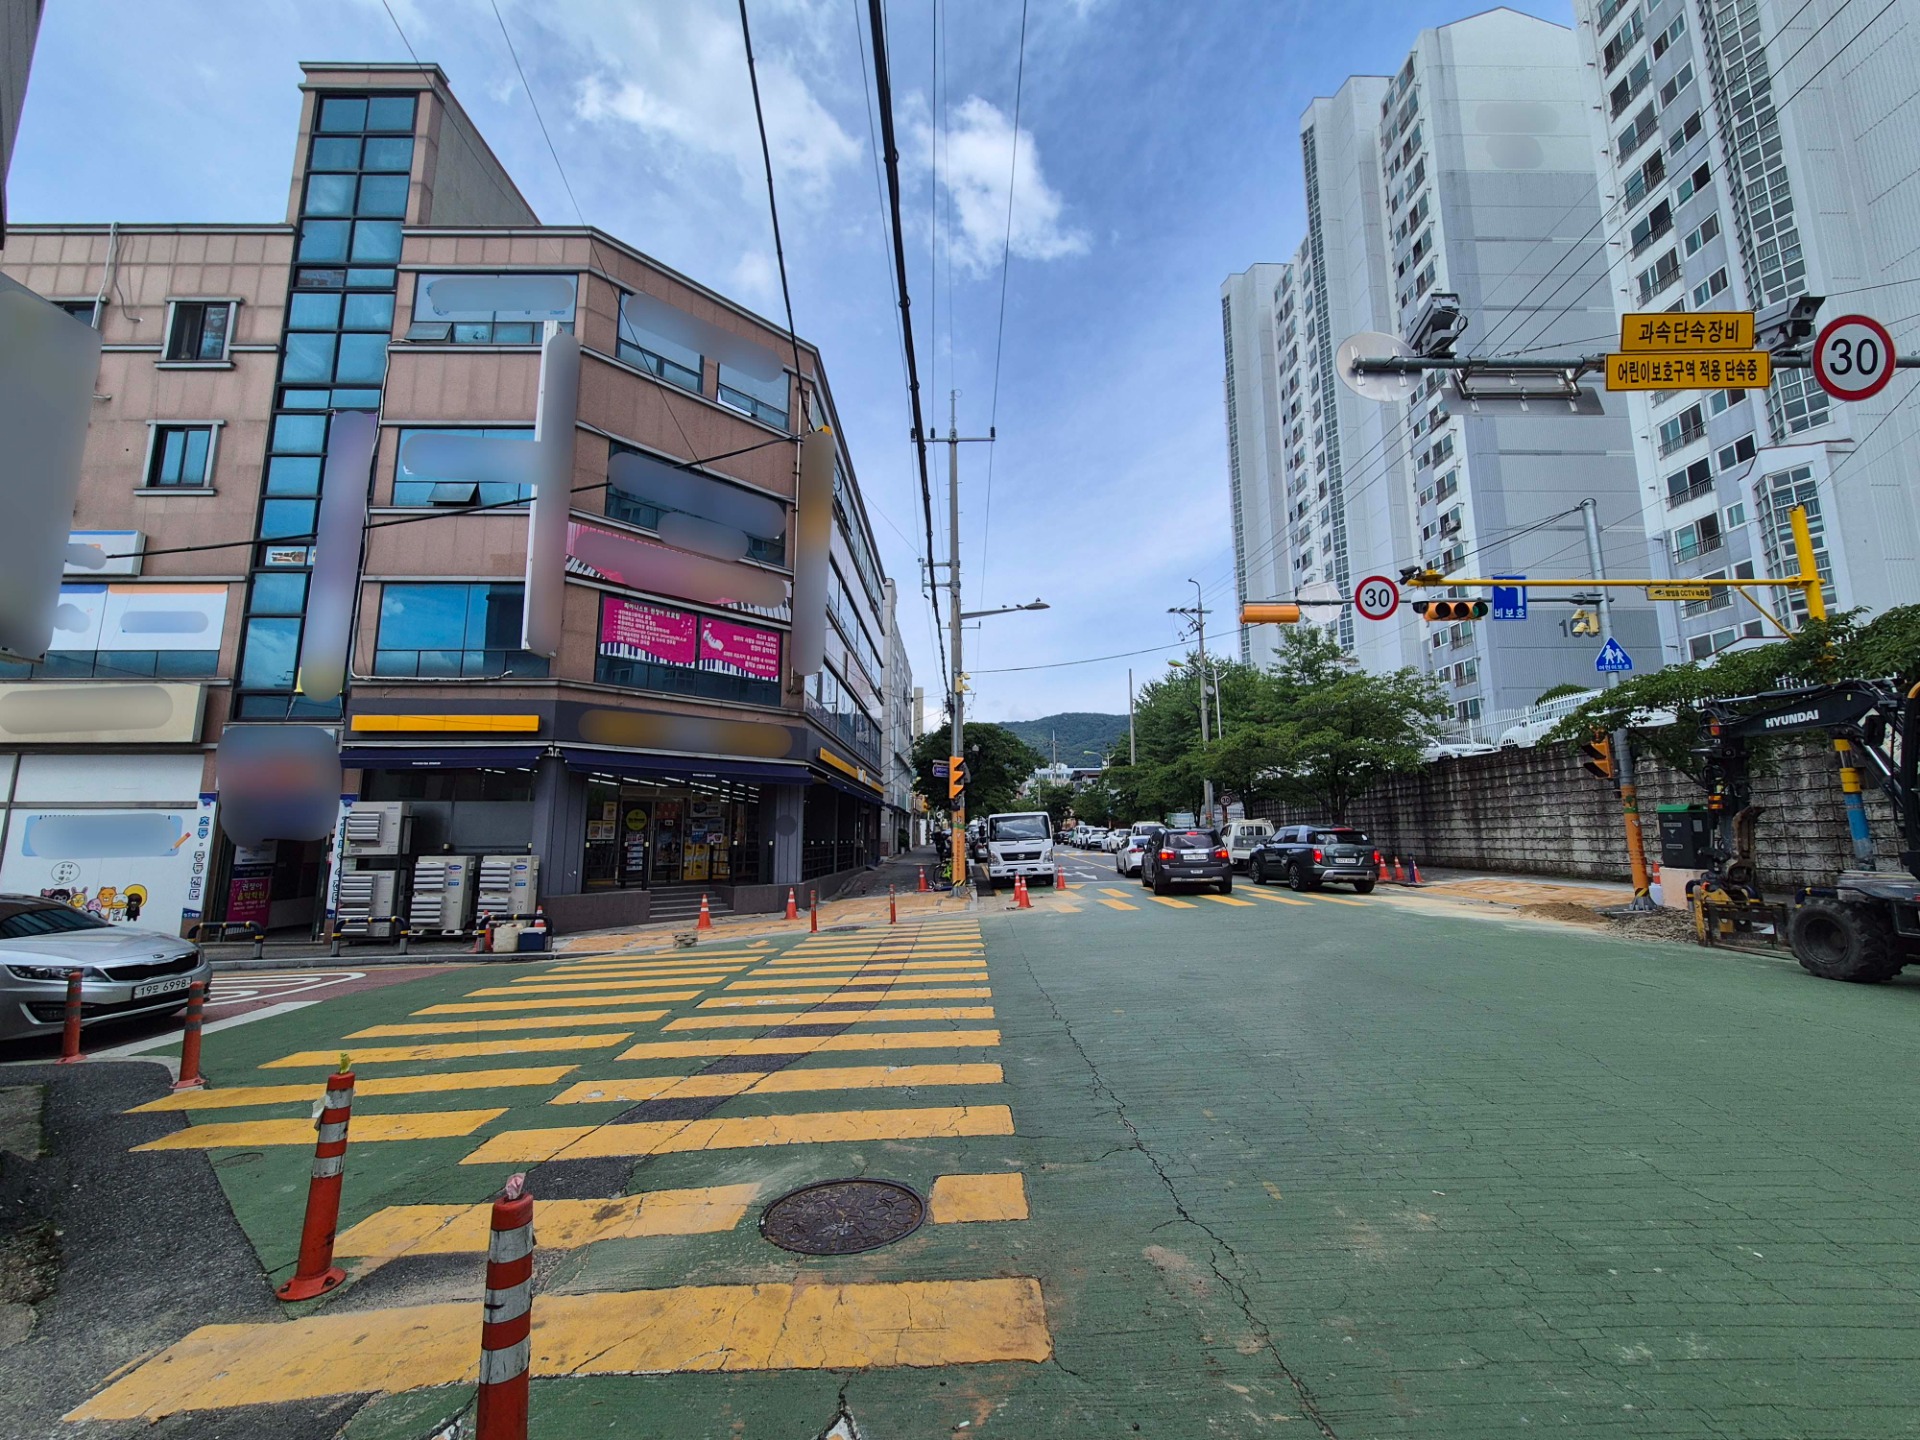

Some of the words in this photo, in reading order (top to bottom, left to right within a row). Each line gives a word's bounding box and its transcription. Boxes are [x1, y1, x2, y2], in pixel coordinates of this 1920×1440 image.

[1638, 319, 1740, 344] 과속단속장비
[1828, 336, 1879, 376] 30
[1617, 359, 1696, 384] 어린이보호구역
[1699, 359, 1721, 382] 적용
[1725, 359, 1758, 382] 단속중
[1364, 589, 1391, 608] 30
[1494, 607, 1526, 619] 비보호
[1765, 709, 1820, 729] HYUNDAI
[241, 881, 263, 891] 권정아
[162, 978, 187, 992] 6998
